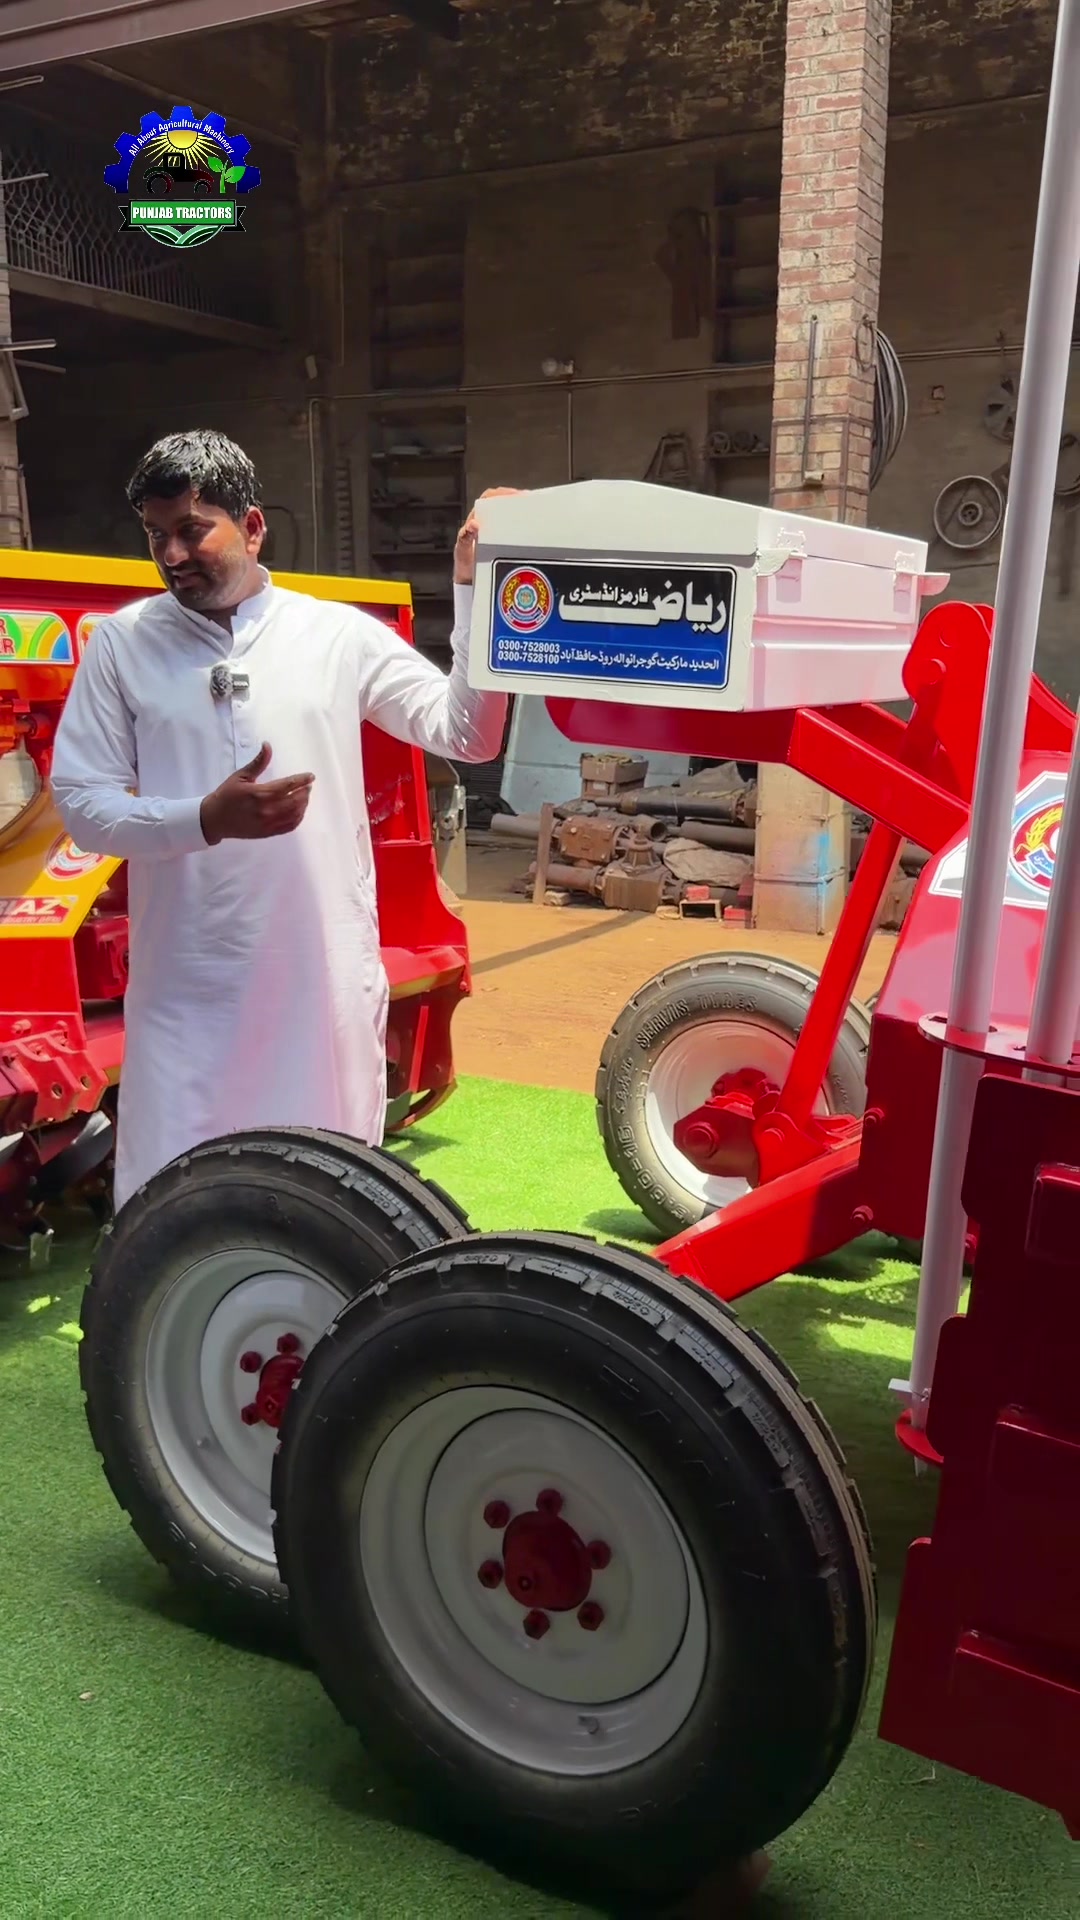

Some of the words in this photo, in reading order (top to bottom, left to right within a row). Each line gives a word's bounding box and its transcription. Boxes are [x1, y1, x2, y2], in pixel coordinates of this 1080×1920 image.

[559, 580, 727, 633] ریاض
[498, 640, 560, 653] 0300-7528003
[498, 651, 560, 664] 0300-7528100
[635, 999, 690, 1050] SERVIS
